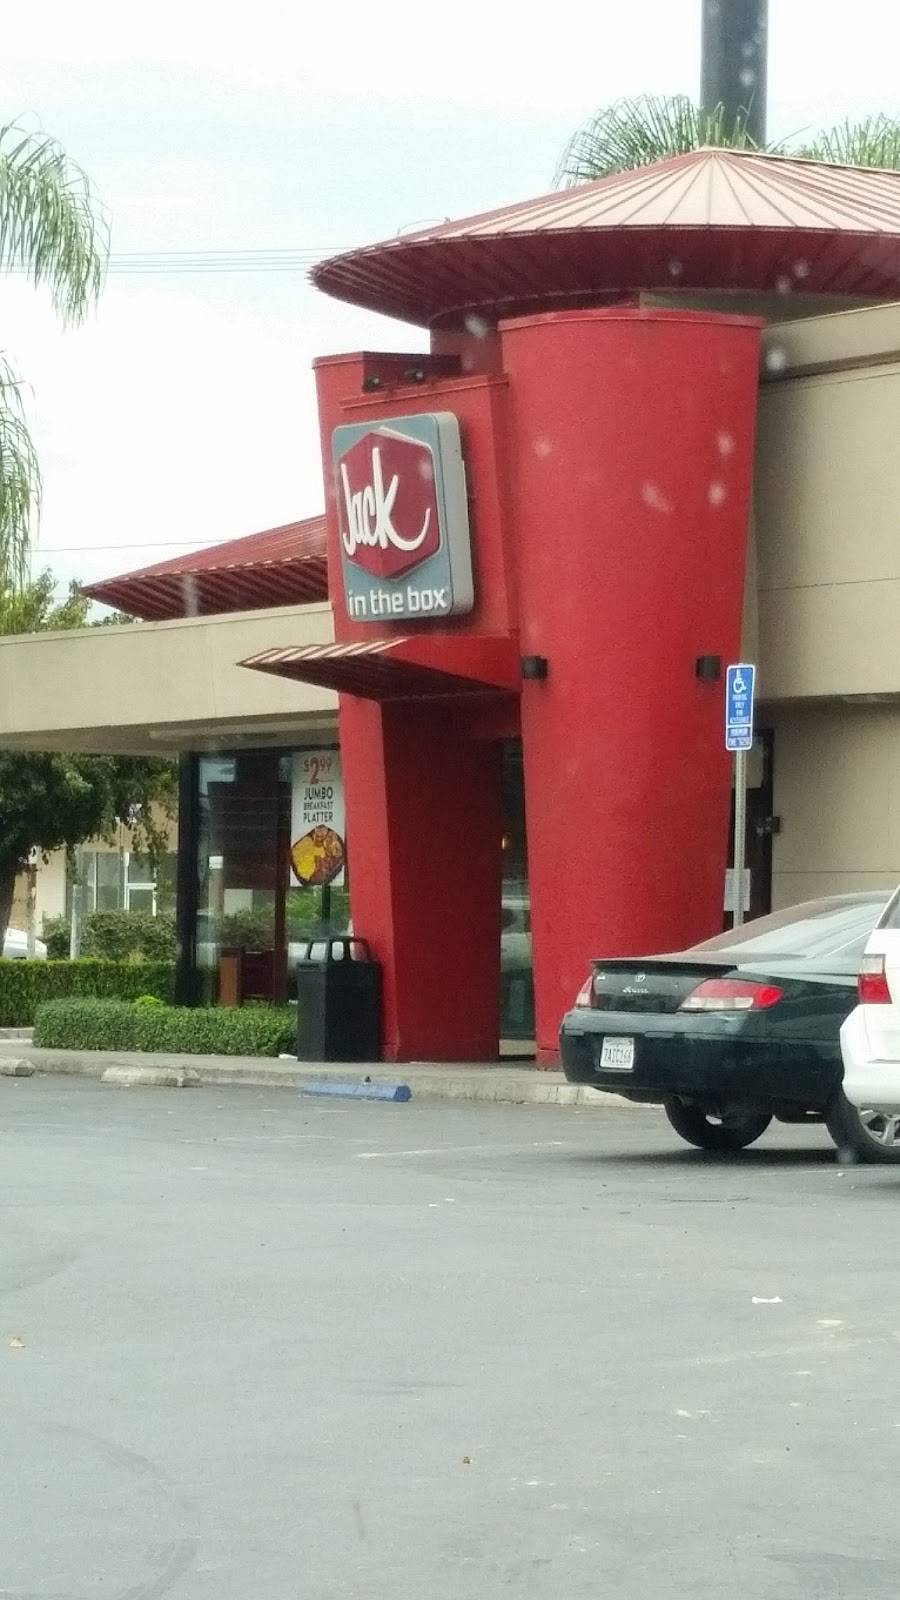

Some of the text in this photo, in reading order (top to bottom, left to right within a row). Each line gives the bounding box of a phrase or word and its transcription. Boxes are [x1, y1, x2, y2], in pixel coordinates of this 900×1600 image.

[341, 446, 431, 556] Jack
[348, 586, 447, 616] in the box
[303, 786, 334, 800] JUMBO
[303, 801, 334, 811] BREAKFAST
[303, 811, 334, 823] PLATTER
